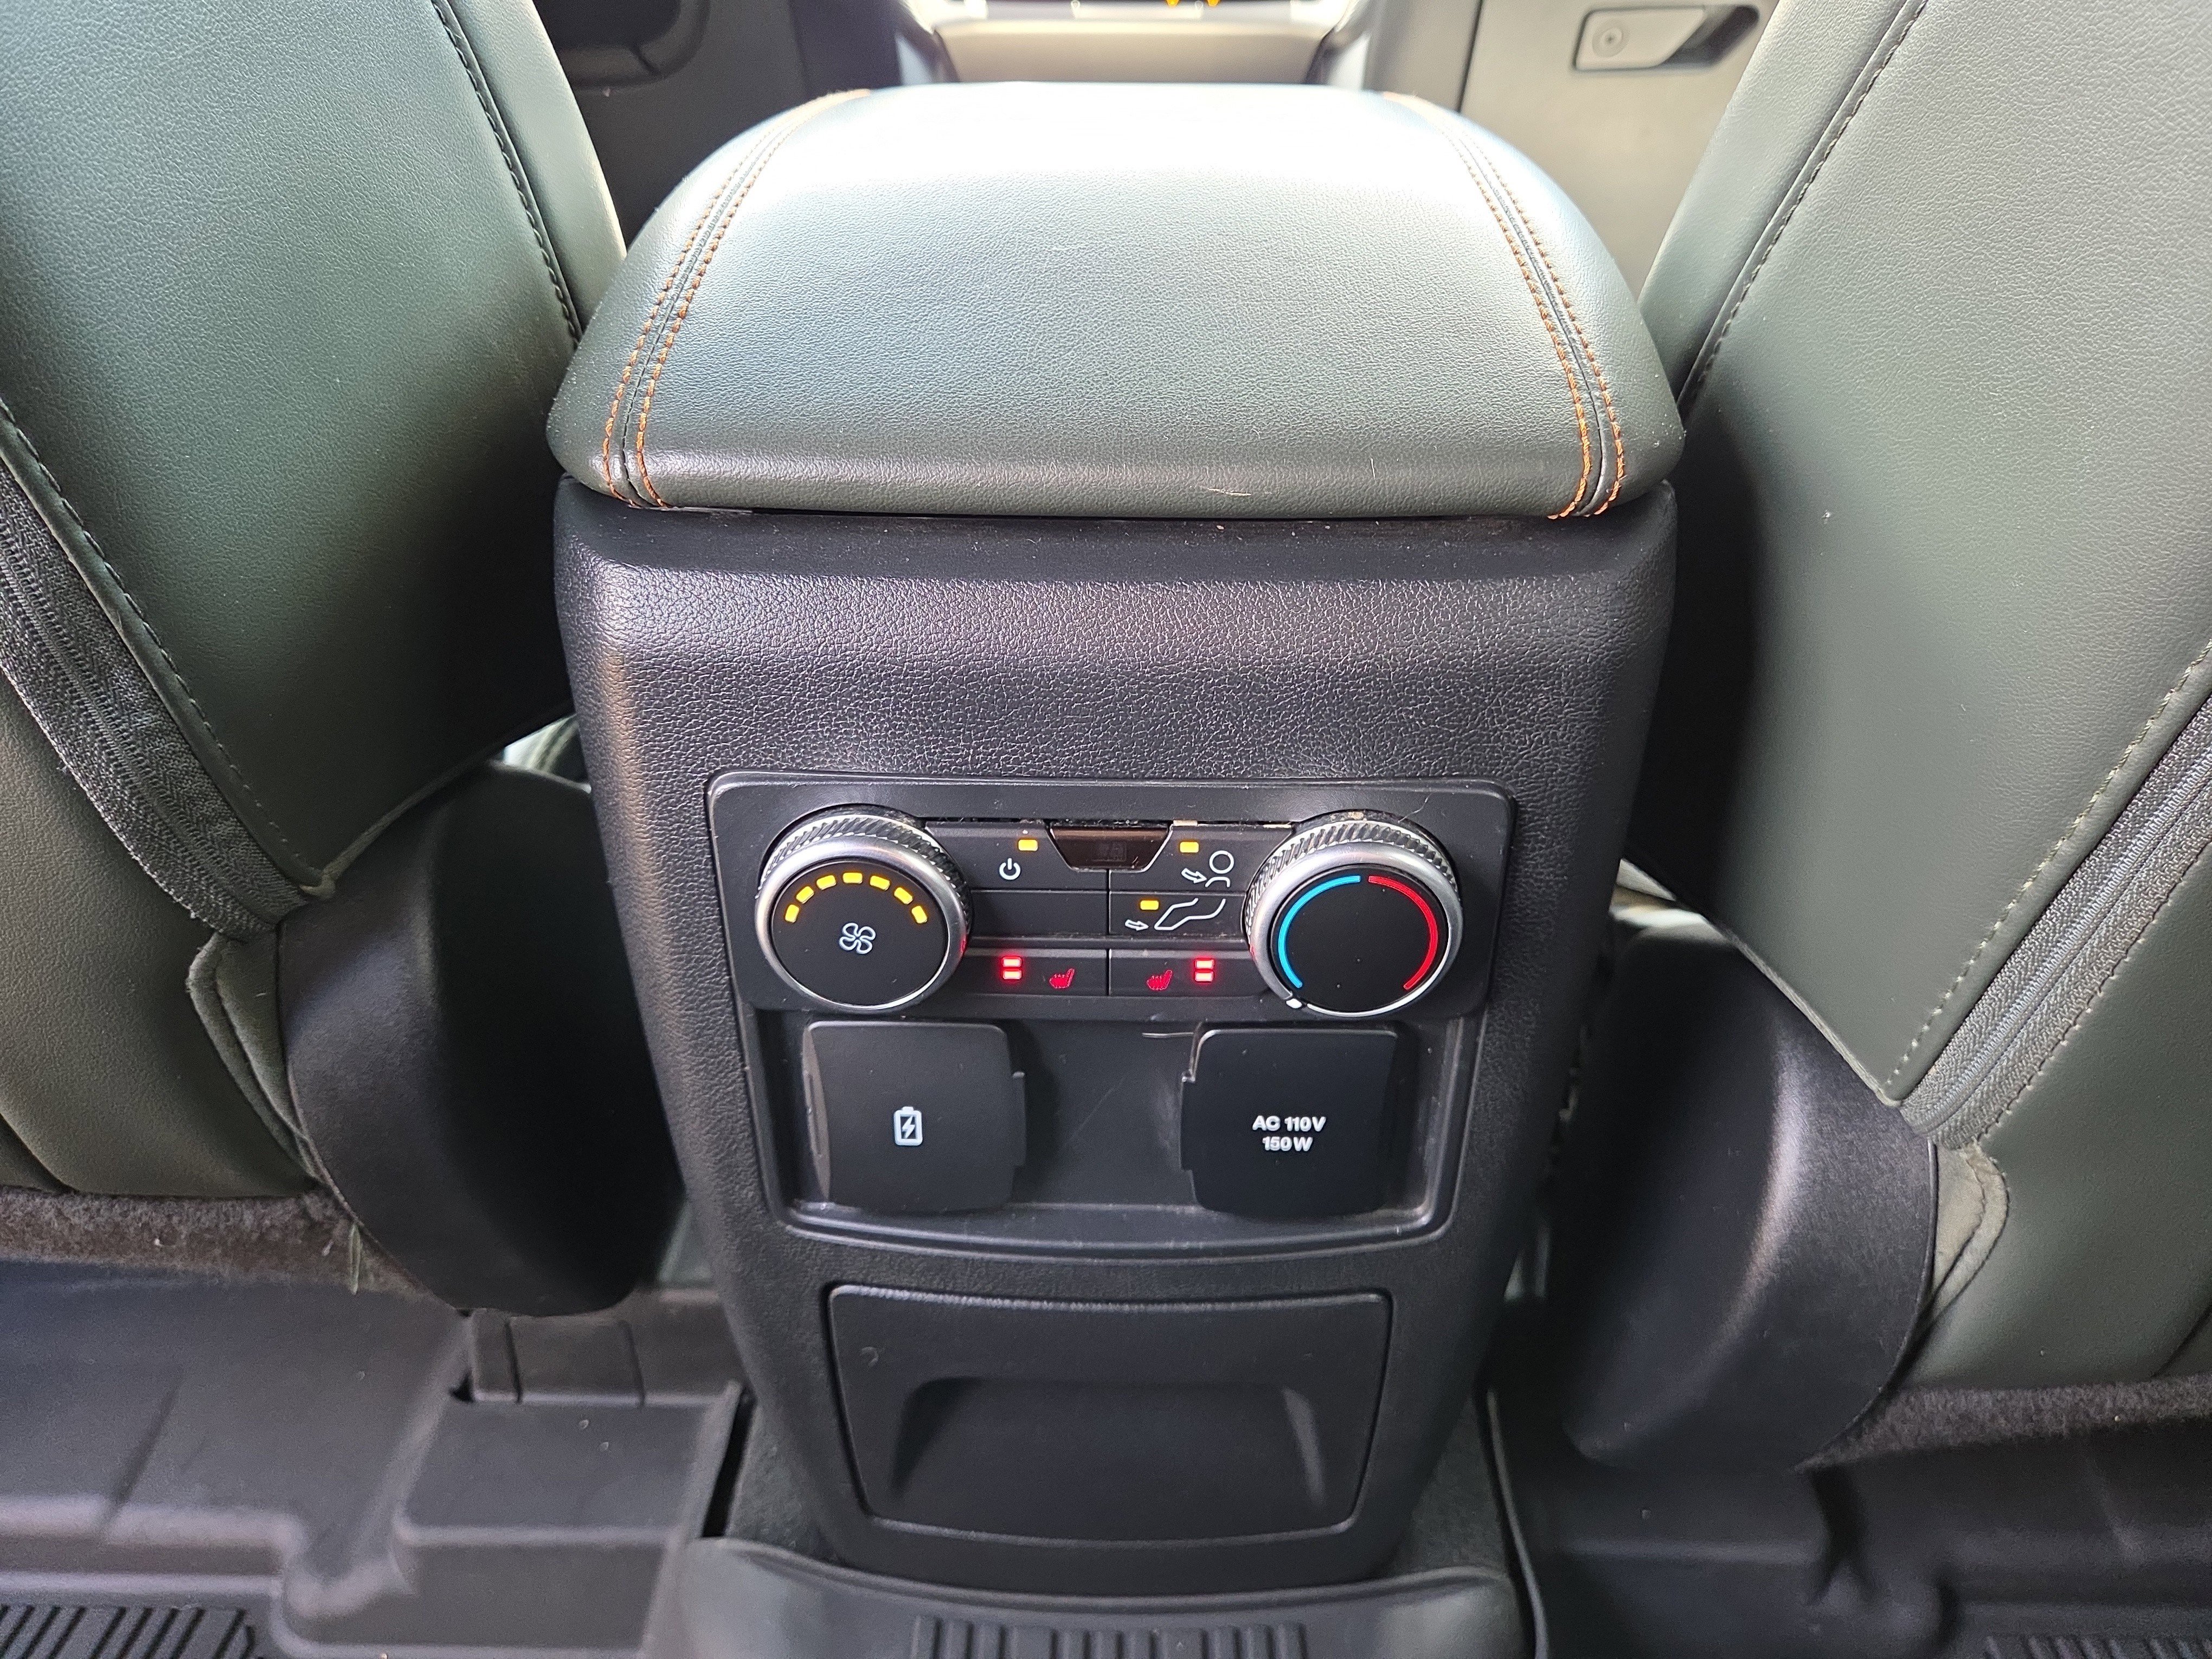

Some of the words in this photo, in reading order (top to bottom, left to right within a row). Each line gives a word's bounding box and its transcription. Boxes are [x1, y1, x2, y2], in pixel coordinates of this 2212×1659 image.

[1252, 1115, 1281, 1131] AC
[1284, 1116, 1326, 1132] 110V
[1262, 1136, 1313, 1152] 150W
